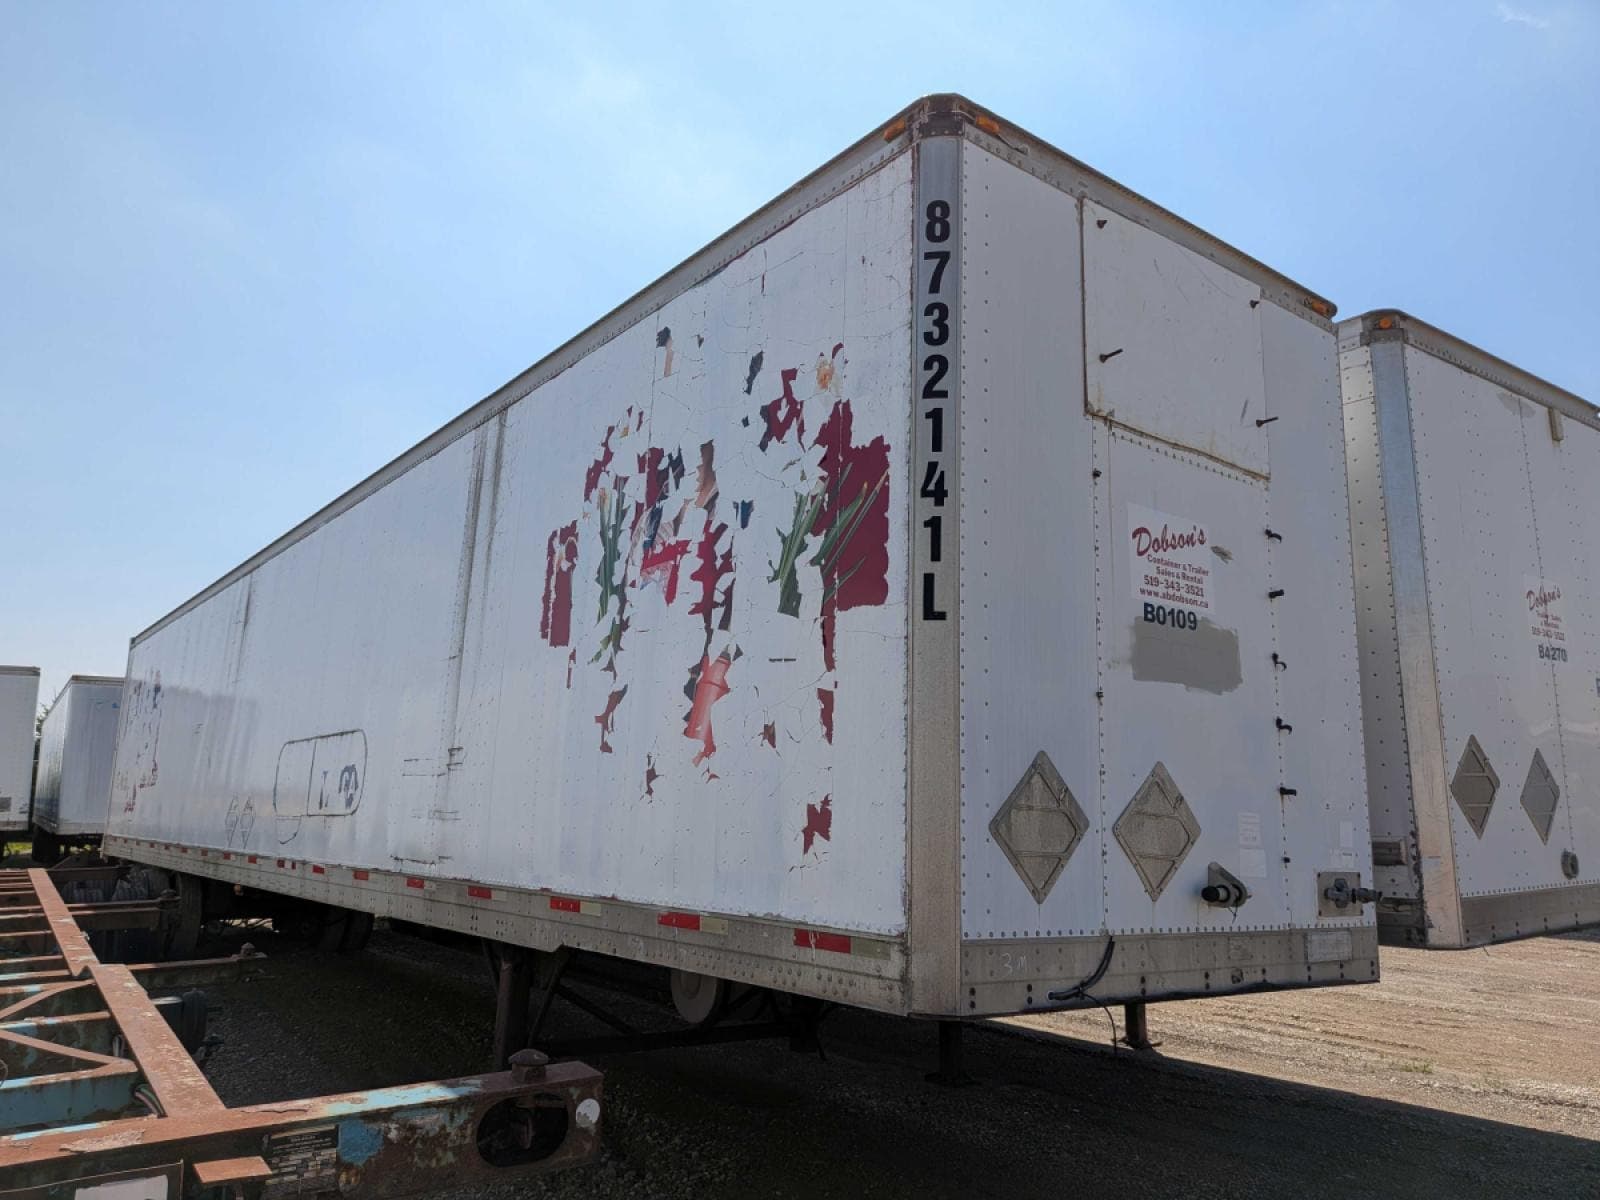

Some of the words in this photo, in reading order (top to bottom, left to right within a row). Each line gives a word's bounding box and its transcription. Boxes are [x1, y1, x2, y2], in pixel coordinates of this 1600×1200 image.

[921, 200, 951, 620] 8732141L
[1132, 524, 1206, 556] Dobson's
[1147, 554, 1181, 569] Container
[1188, 564, 1209, 577] Trailer
[1156, 566, 1175, 578] Sales
[1143, 574, 1205, 598] 519-343-3521
[1143, 602, 1198, 631] B0109
[1538, 644, 1568, 663] B4270
